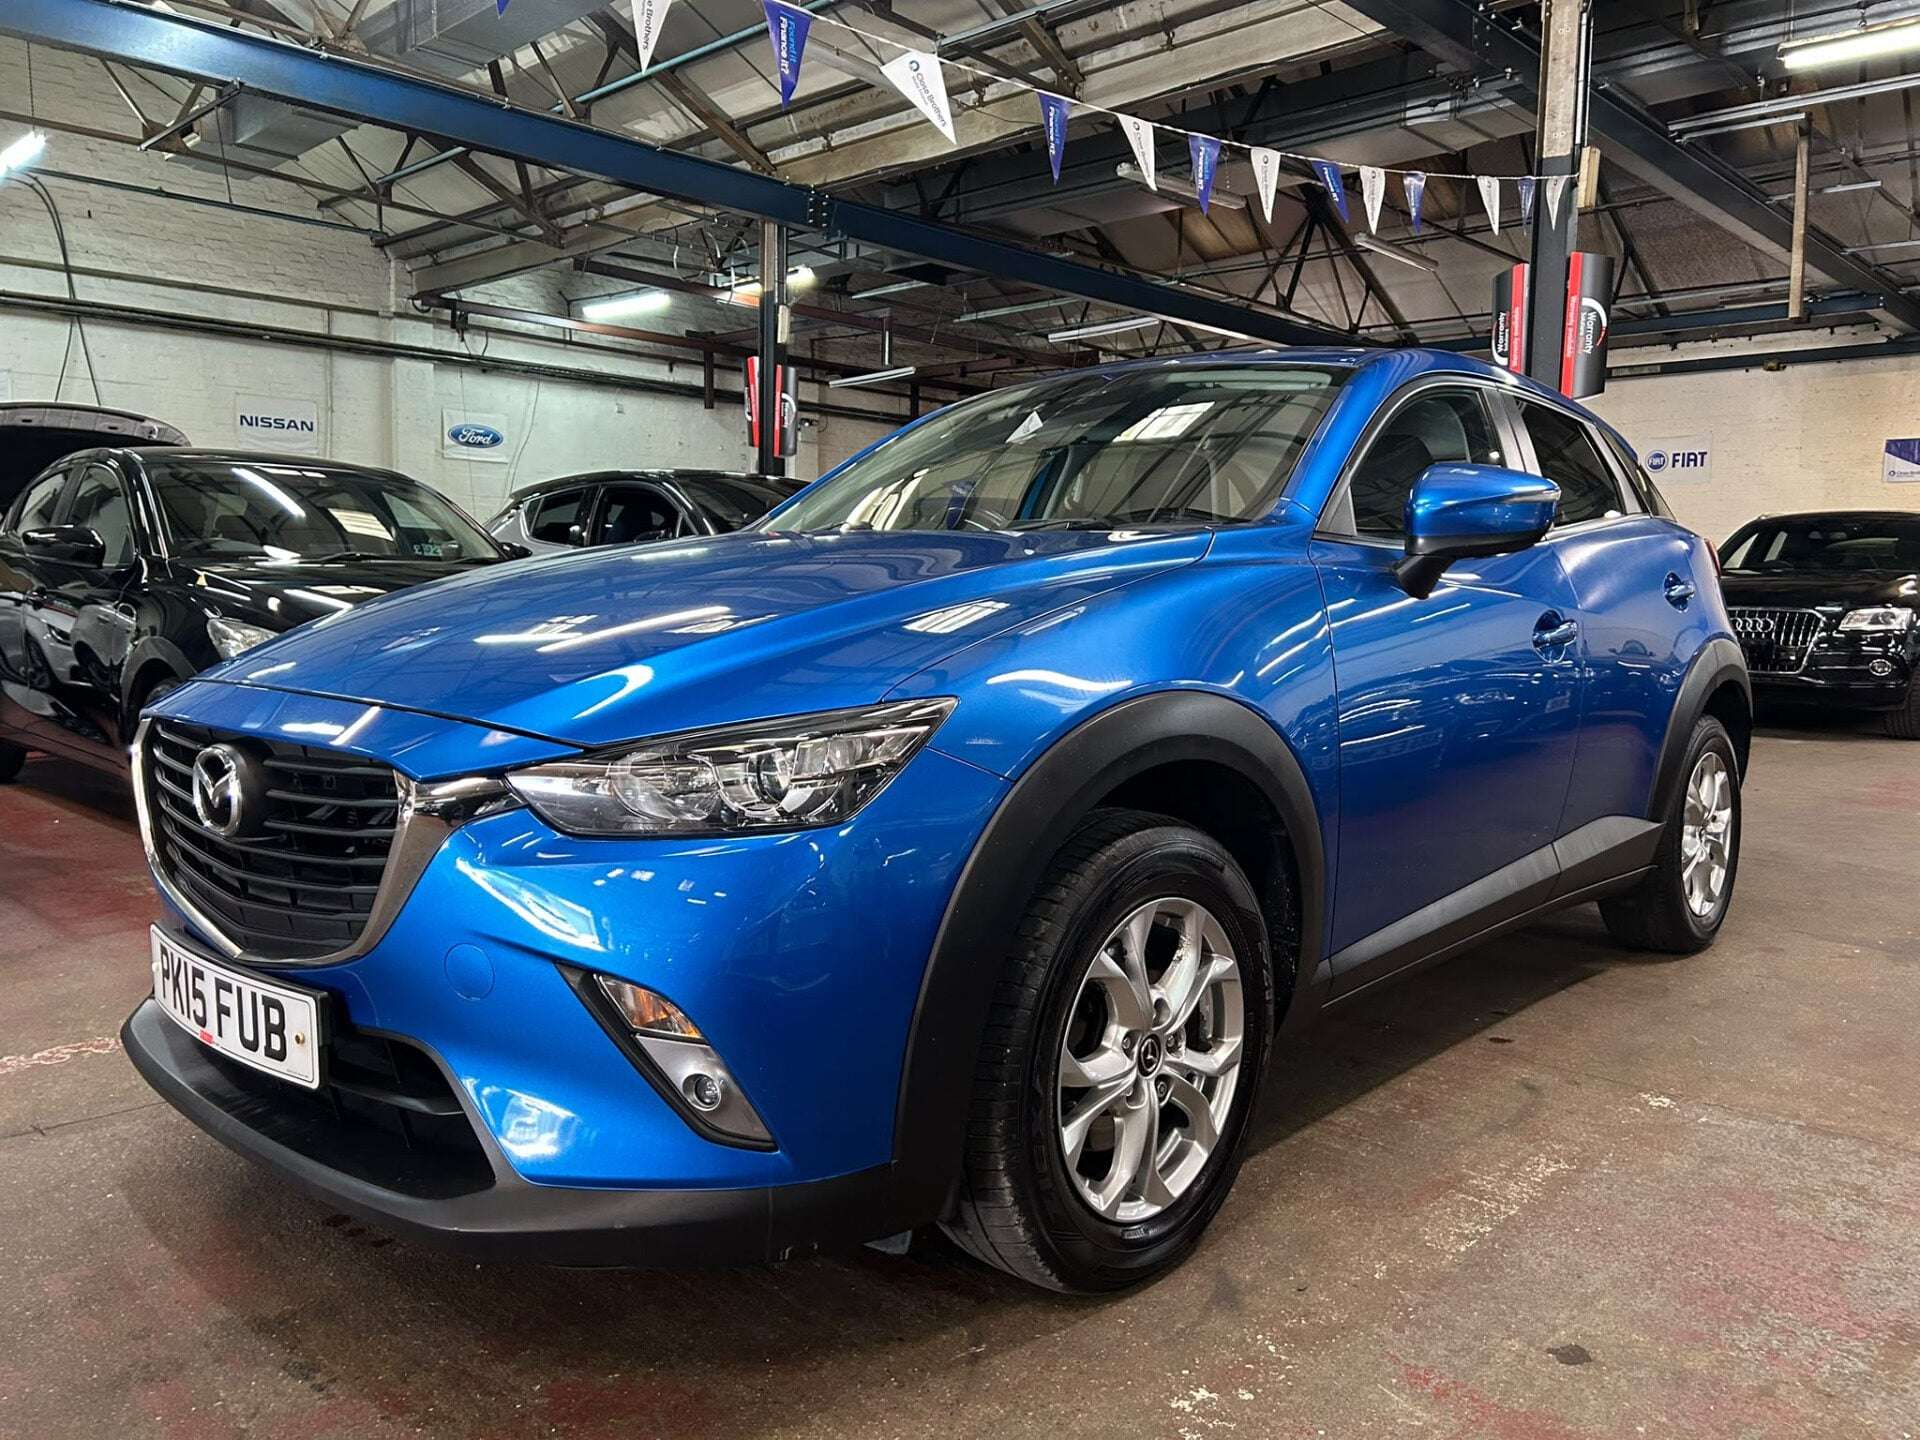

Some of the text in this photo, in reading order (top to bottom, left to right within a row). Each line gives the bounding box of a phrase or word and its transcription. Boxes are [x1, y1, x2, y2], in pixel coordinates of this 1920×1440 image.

[643, 8, 653, 50] Brothers
[780, 16, 790, 75] Finance it?
[788, 21, 797, 54] Found
[916, 73, 929, 94] Close
[928, 94, 947, 127] Brothers
[1497, 312, 1506, 353] Warranty
[1583, 311, 1597, 354] Warranty
[240, 414, 313, 432] NISSAN
[458, 428, 493, 445] Ford
[1648, 451, 1708, 468] FIAT FIAT
[160, 943, 287, 1062] PK15 FUB
